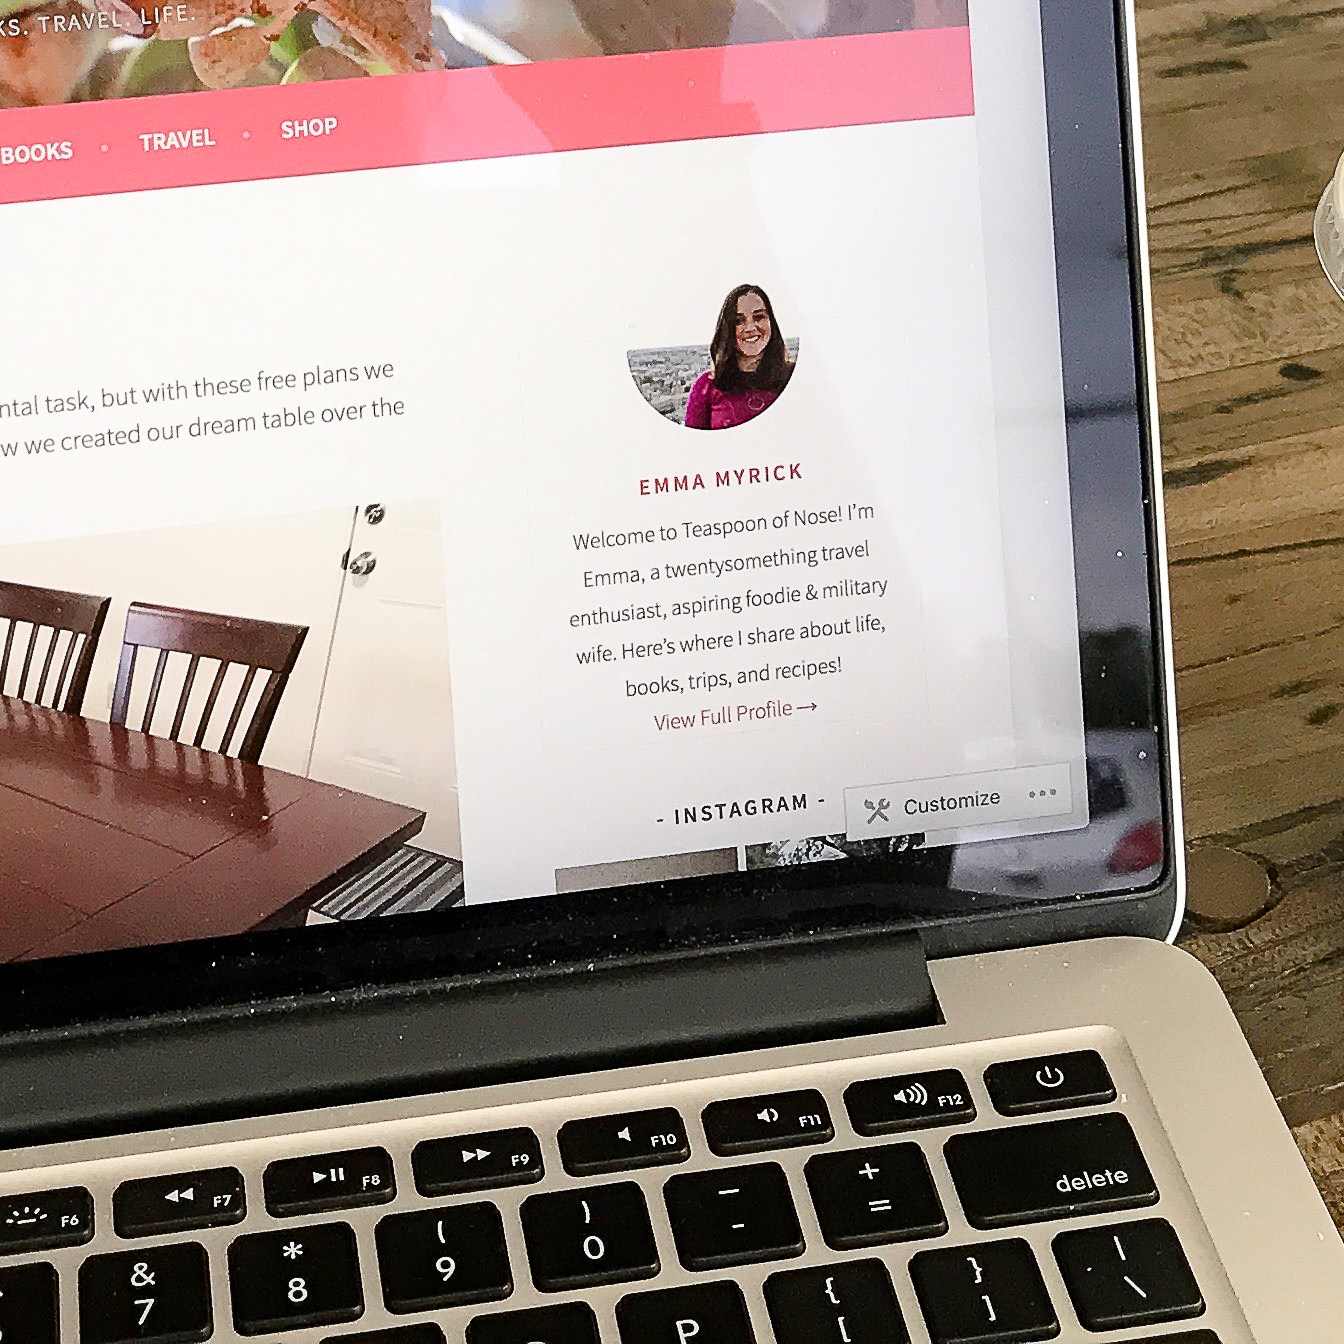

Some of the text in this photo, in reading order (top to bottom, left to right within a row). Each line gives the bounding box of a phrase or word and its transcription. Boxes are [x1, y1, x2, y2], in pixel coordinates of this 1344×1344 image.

[140, 3, 196, 27] LIFE.
[0, 140, 73, 165] BOOKS
[140, 128, 215, 153] TRAVEL
[281, 116, 337, 139] SHOP
[45, 390, 95, 415] task,
[101, 385, 138, 409] but
[143, 379, 188, 403] with
[193, 374, 252, 399] these
[257, 369, 297, 392] free
[302, 363, 360, 391] plans
[364, 362, 394, 380] we
[24, 436, 56, 455] we
[61, 423, 142, 451] created
[147, 422, 184, 442] our
[189, 414, 257, 438] dream
[262, 405, 315, 429] table
[320, 401, 367, 423] over
[371, 396, 405, 418] the
[639, 463, 802, 496] EMMA MYRICK
[572, 527, 655, 550] Welcome
[659, 523, 678, 541] to
[682, 515, 768, 541] Teaspoon
[772, 510, 789, 530] of
[794, 505, 843, 527] Nose!
[583, 540, 869, 588] Emma, a twentysomething travel
[569, 576, 888, 628] enthusiast, aspiring foodie & military
[576, 644, 617, 665] wife.
[679, 631, 734, 653] where
[737, 630, 741, 646] I
[747, 623, 795, 645] share
[799, 617, 851, 640] about
[854, 614, 886, 635] life,
[625, 656, 842, 699] books, trips, and recipes!
[654, 699, 793, 731] View Full Profile
[674, 794, 808, 826] INSTAGRAM
[904, 790, 1001, 817] Customize
[938, 1093, 964, 1108] F12
[799, 1113, 822, 1128] F11
[650, 1133, 677, 1148] F10
[510, 1153, 530, 1168] F9
[362, 1173, 381, 1188] F8
[1055, 1166, 1129, 1193] delete
[213, 1193, 232, 1209] F7
[61, 1212, 79, 1228] F6
[583, 1235, 605, 1260] 0
[435, 1257, 456, 1281] 9
[288, 1278, 308, 1303] 8
[134, 1300, 156, 1326] 7
